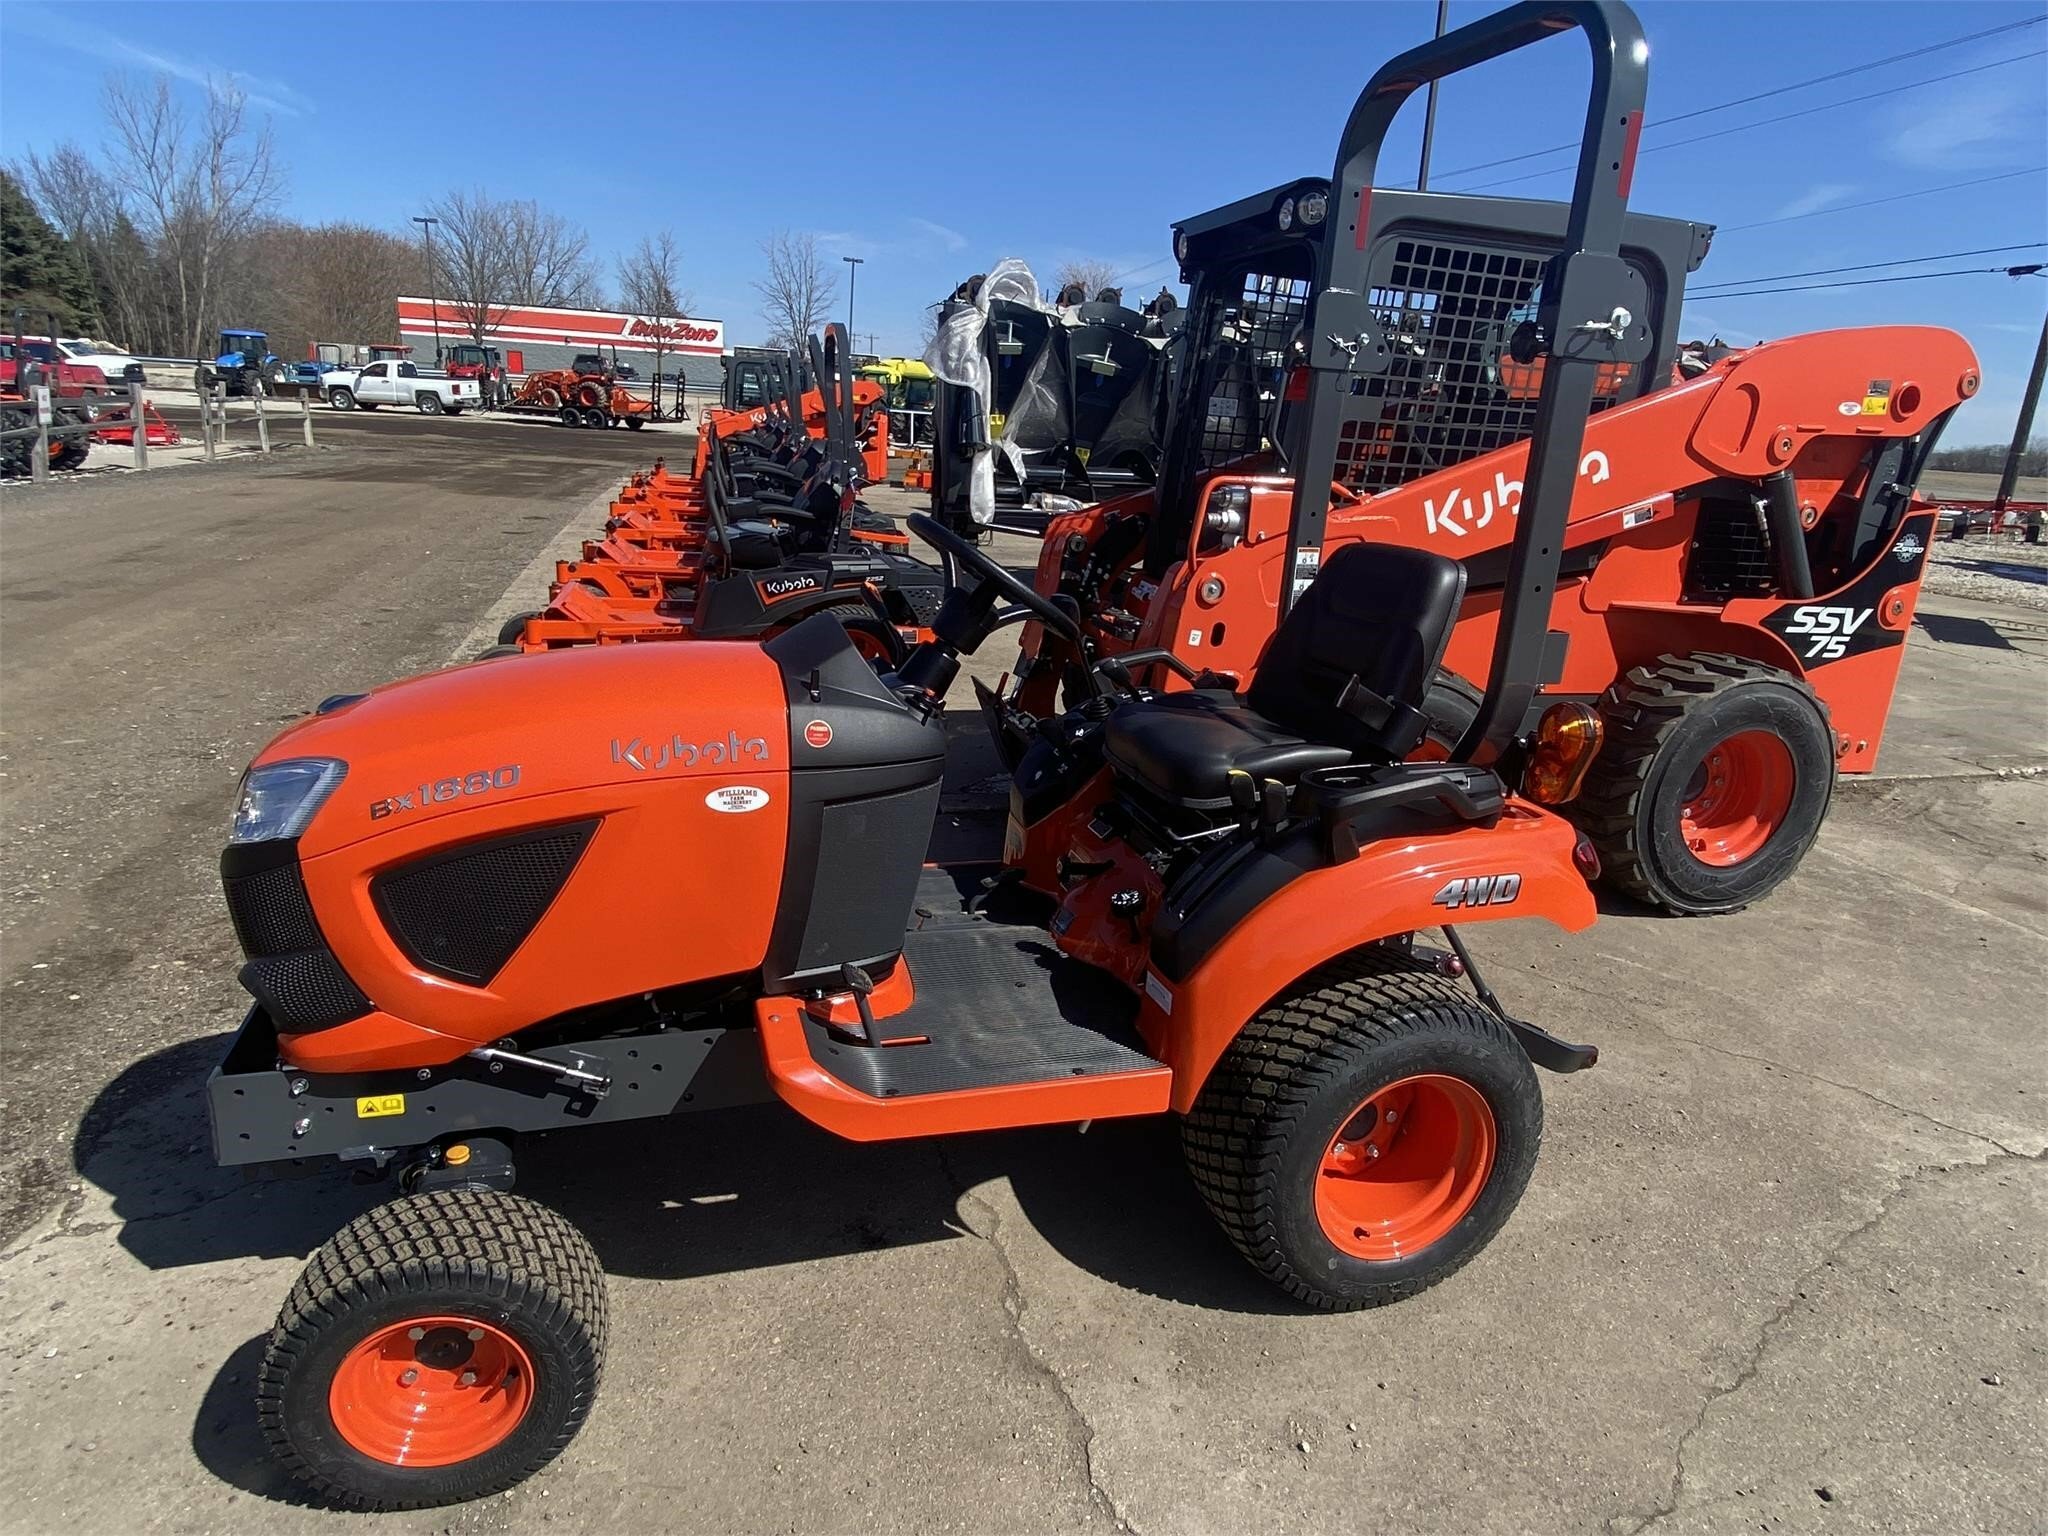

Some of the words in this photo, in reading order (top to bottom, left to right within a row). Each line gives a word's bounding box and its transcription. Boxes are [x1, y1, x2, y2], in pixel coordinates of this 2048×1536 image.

[628, 319, 718, 342] AutoZone
[1424, 450, 1609, 536] Kuba
[767, 577, 815, 593] Kubota
[1785, 606, 1874, 635] SSV
[1804, 636, 1851, 658] 75
[611, 730, 769, 771] Kubota
[370, 764, 521, 820] BX1880
[717, 789, 758, 797] WILLIAMS
[1432, 873, 1522, 909] 4WD
